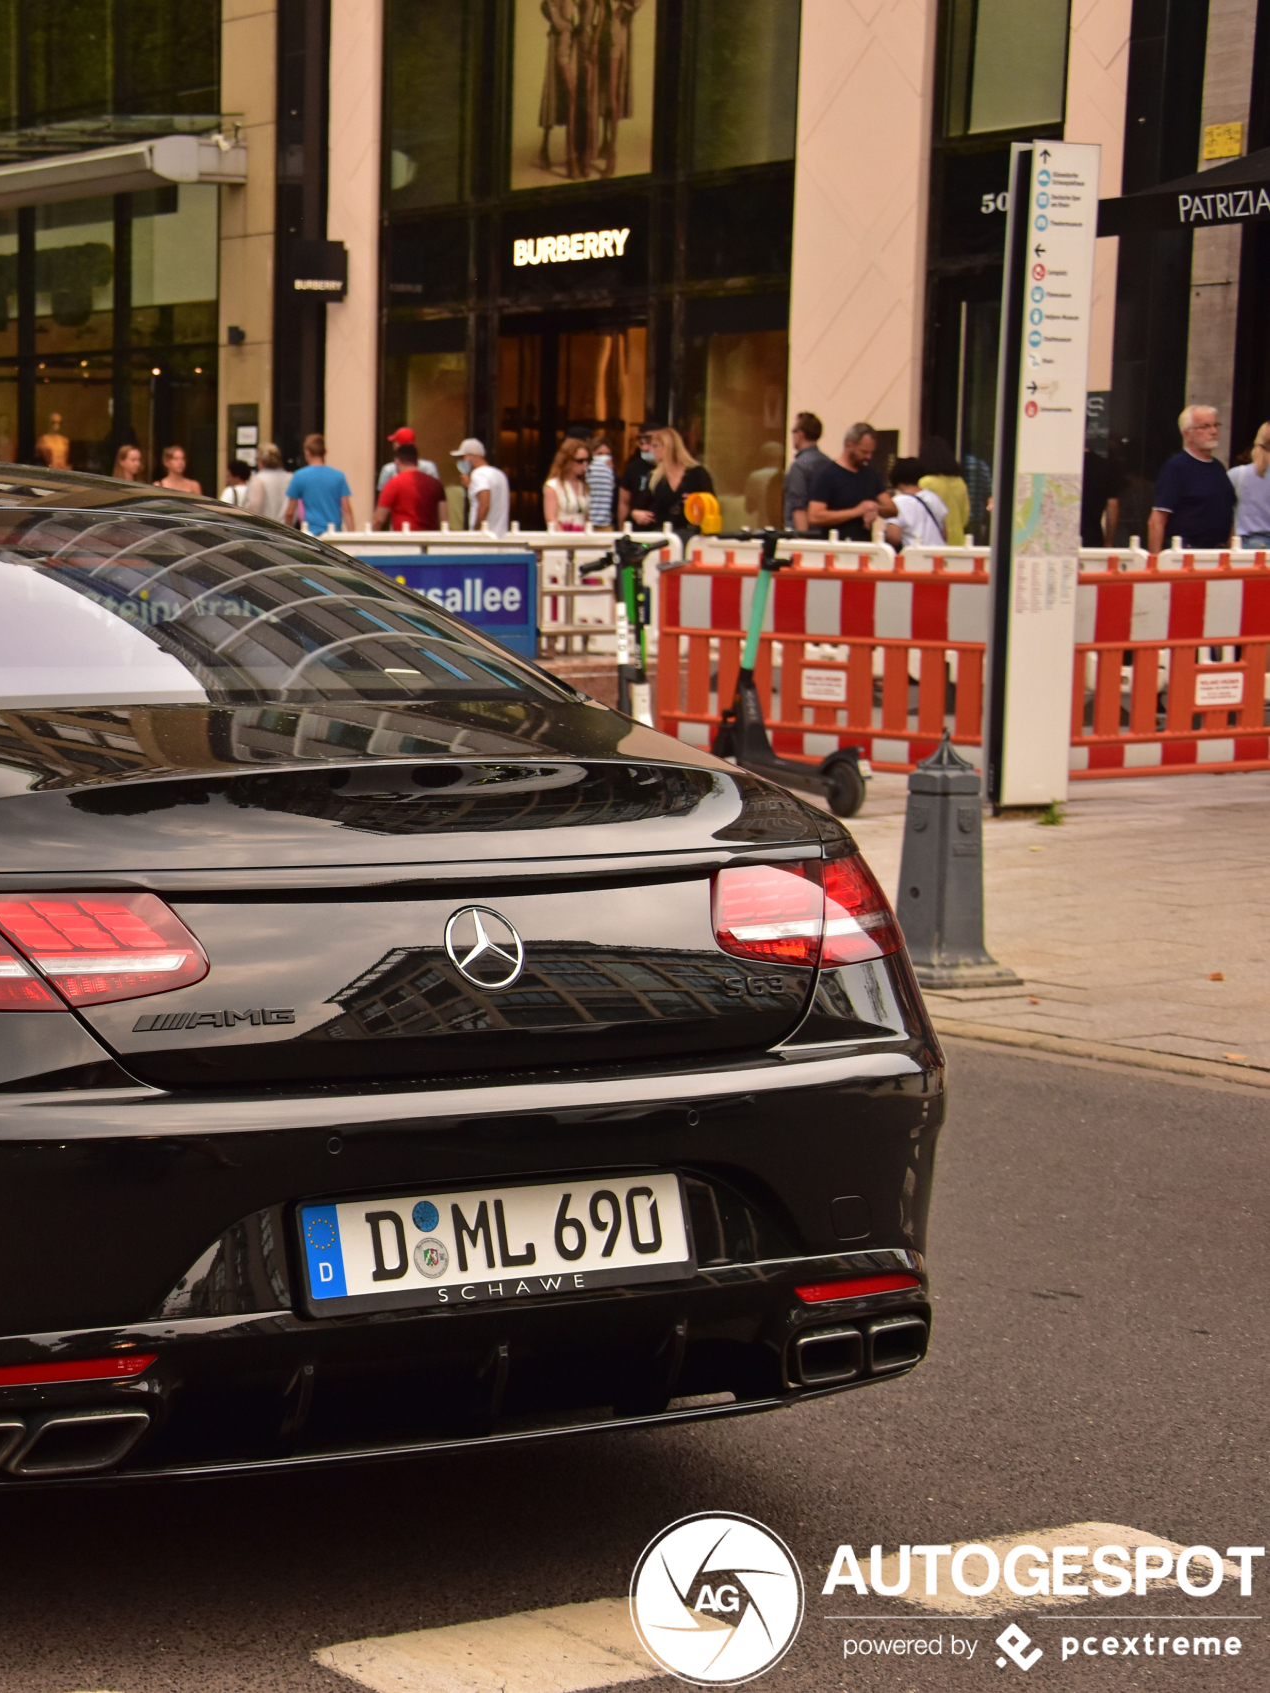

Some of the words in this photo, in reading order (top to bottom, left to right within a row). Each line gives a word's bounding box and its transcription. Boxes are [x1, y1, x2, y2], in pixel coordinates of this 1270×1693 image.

[1178, 188, 1270, 222] PATRIZIA
[513, 227, 631, 267] BURBERRY
[185, 1007, 296, 1030] AMG
[364, 1209, 410, 1283] D
[449, 1197, 537, 1273] ML
[553, 1186, 664, 1262] 690
[318, 1262, 334, 1283] D
[437, 1273, 586, 1303] SCHAWE
